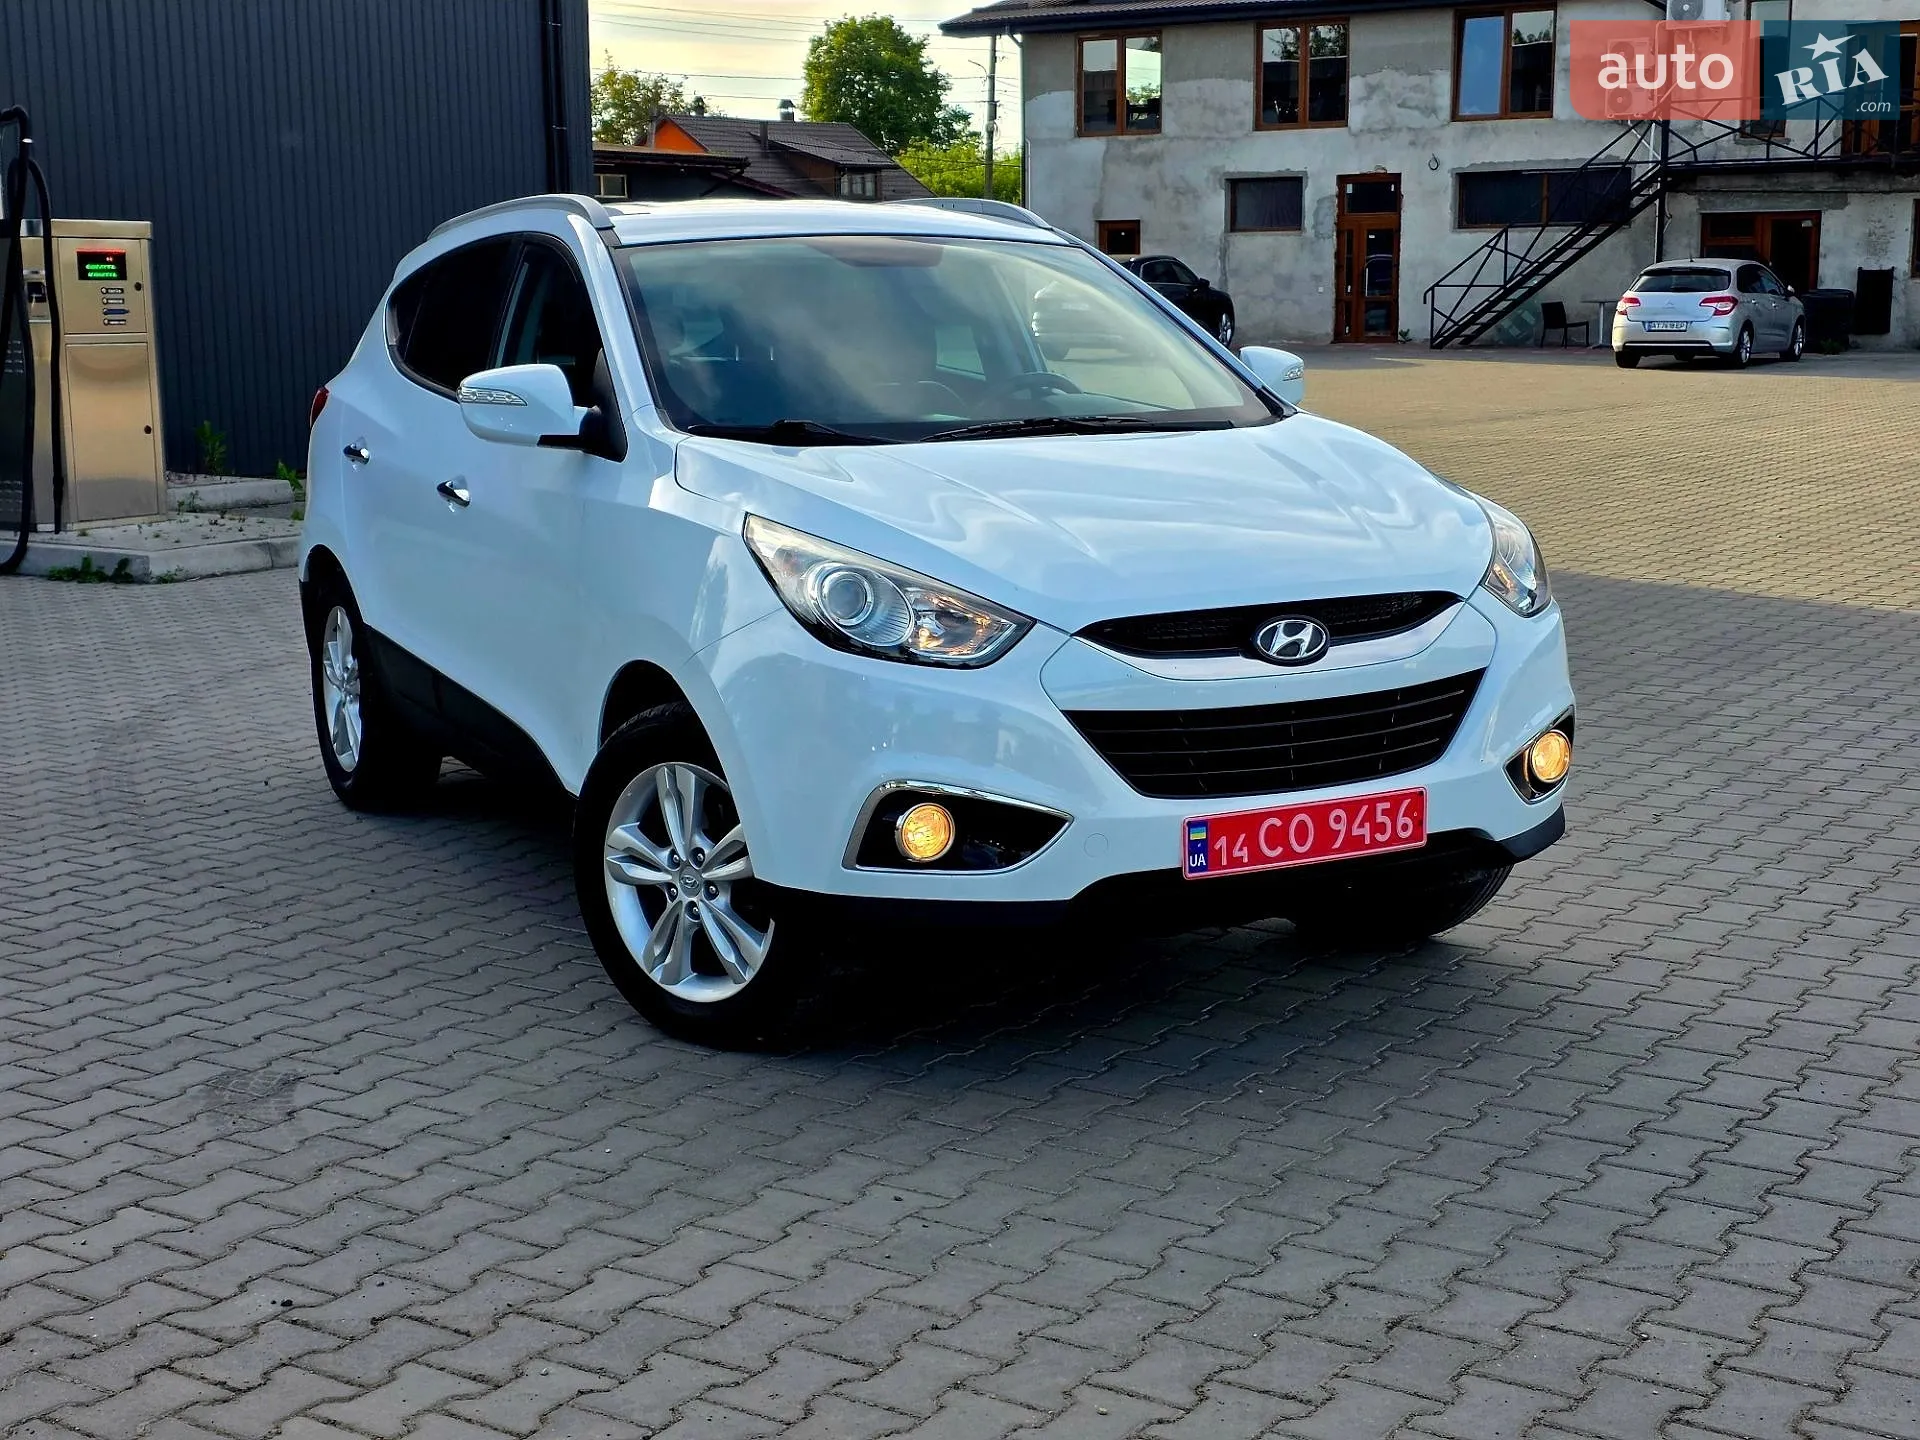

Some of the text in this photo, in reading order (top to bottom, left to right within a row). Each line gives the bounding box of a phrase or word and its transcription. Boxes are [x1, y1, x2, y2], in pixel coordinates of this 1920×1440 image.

[1213, 798, 1414, 866] 14 CO 9456
[1189, 853, 1206, 867] UA
